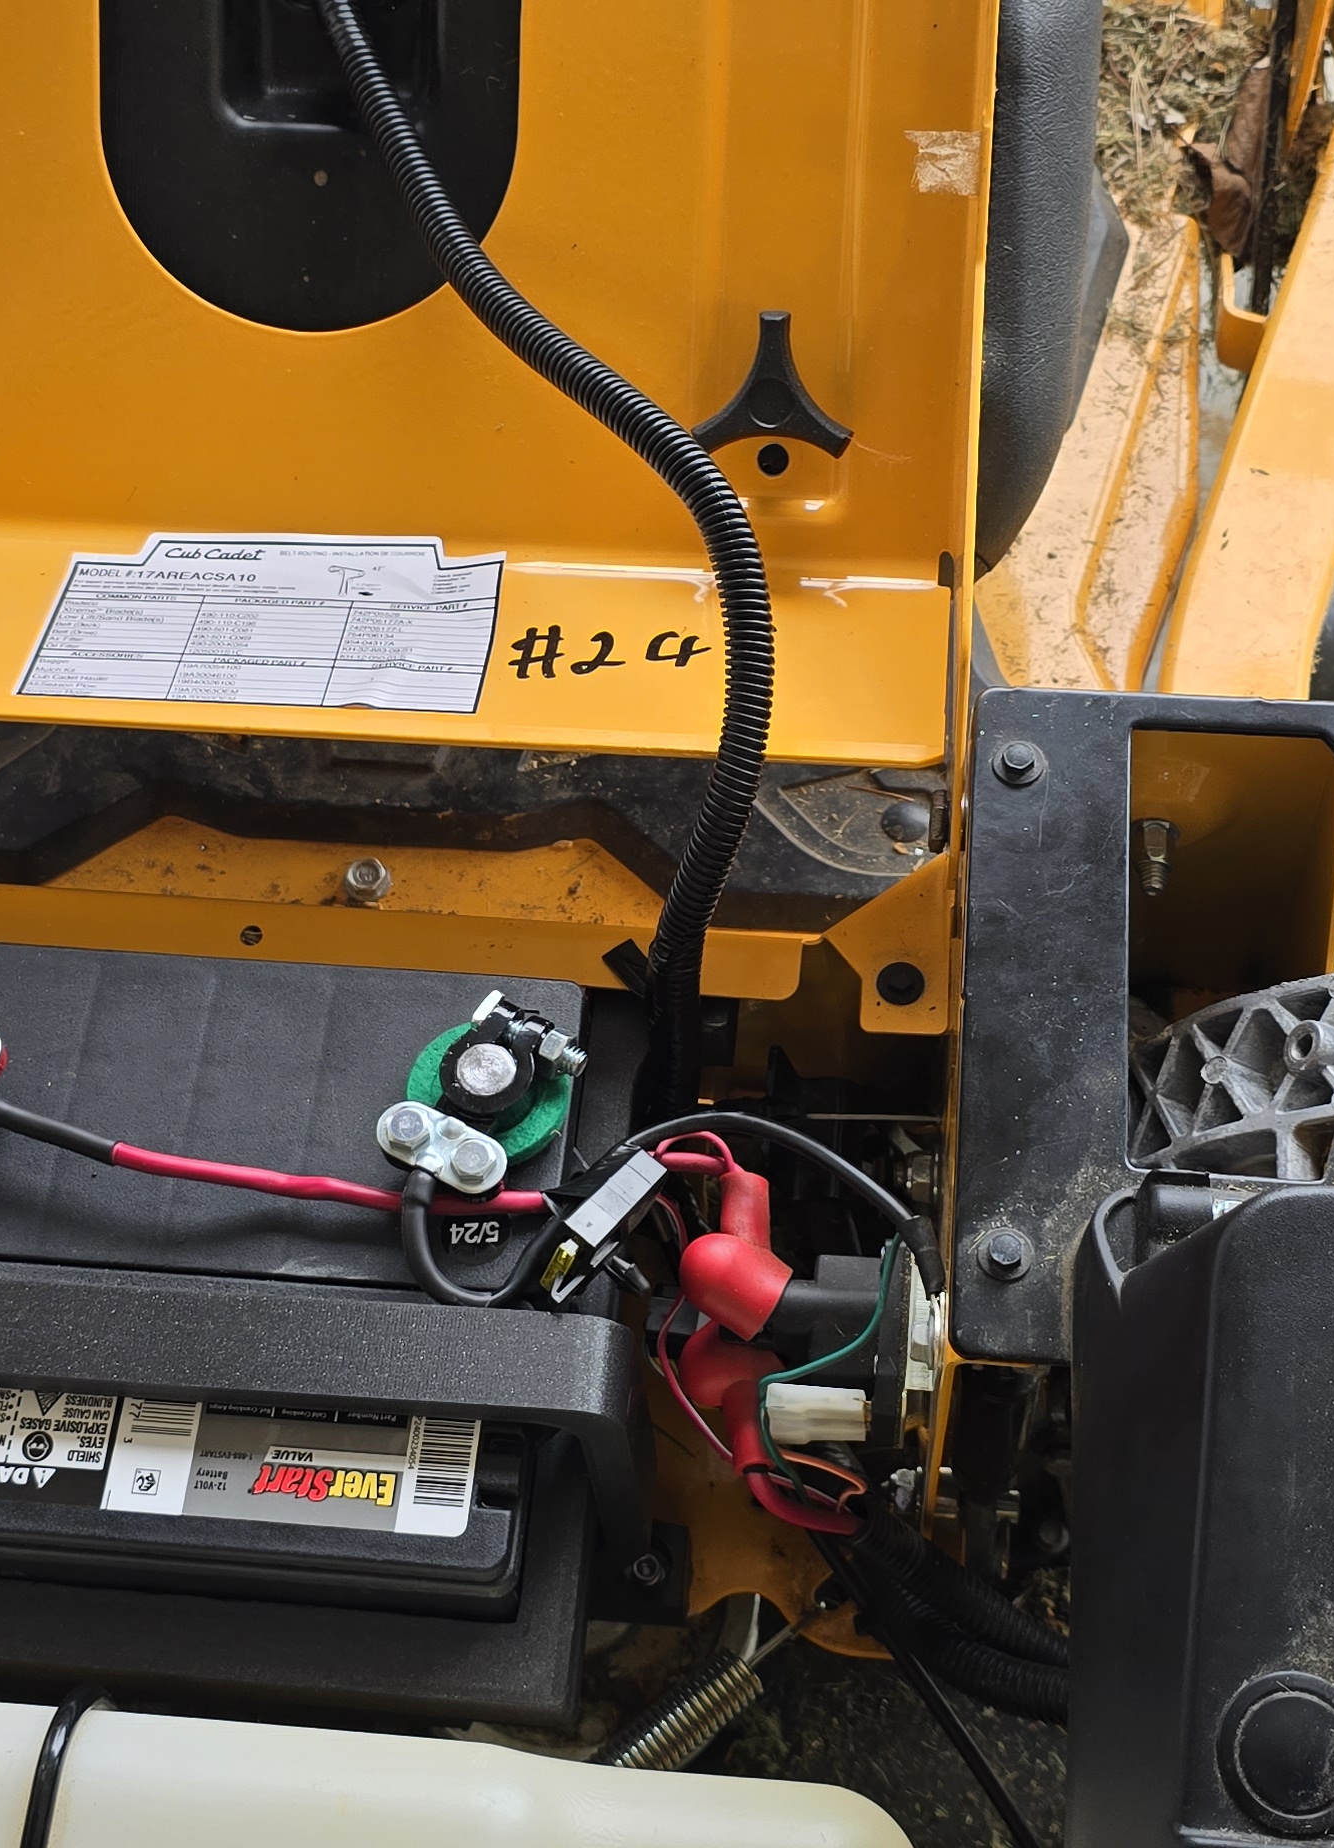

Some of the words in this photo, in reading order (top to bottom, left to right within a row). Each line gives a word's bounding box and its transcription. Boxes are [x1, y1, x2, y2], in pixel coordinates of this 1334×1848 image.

[165, 548, 201, 559] Cub
[204, 549, 266, 560] Cadet
[78, 569, 121, 577] MODEL
[436, 603, 460, 611] PART
[125, 615, 164, 624] Blade(s)
[212, 657, 269, 665] PACKAGED
[449, 1221, 500, 1244] 5/24
[65, 1395, 113, 1407] BLINDNESS
[61, 1407, 91, 1419] CAUSE
[91, 1409, 110, 1420] CAN
[229, 1404, 257, 1413] Cranking
[281, 1408, 311, 1417] Cranking
[347, 1411, 378, 1420] Number
[379, 1413, 396, 1421] Part
[19, 1417, 52, 1430] GASES
[52, 1419, 108, 1433] EXPLOSIVE
[76, 1435, 105, 1448] EYES.
[67, 1450, 102, 1463] SHIELD
[271, 1449, 314, 1463] VALUE
[195, 1467, 228, 1480] Battery
[193, 1480, 227, 1491] 12-VOLT
[250, 1462, 397, 1507] EverStart
